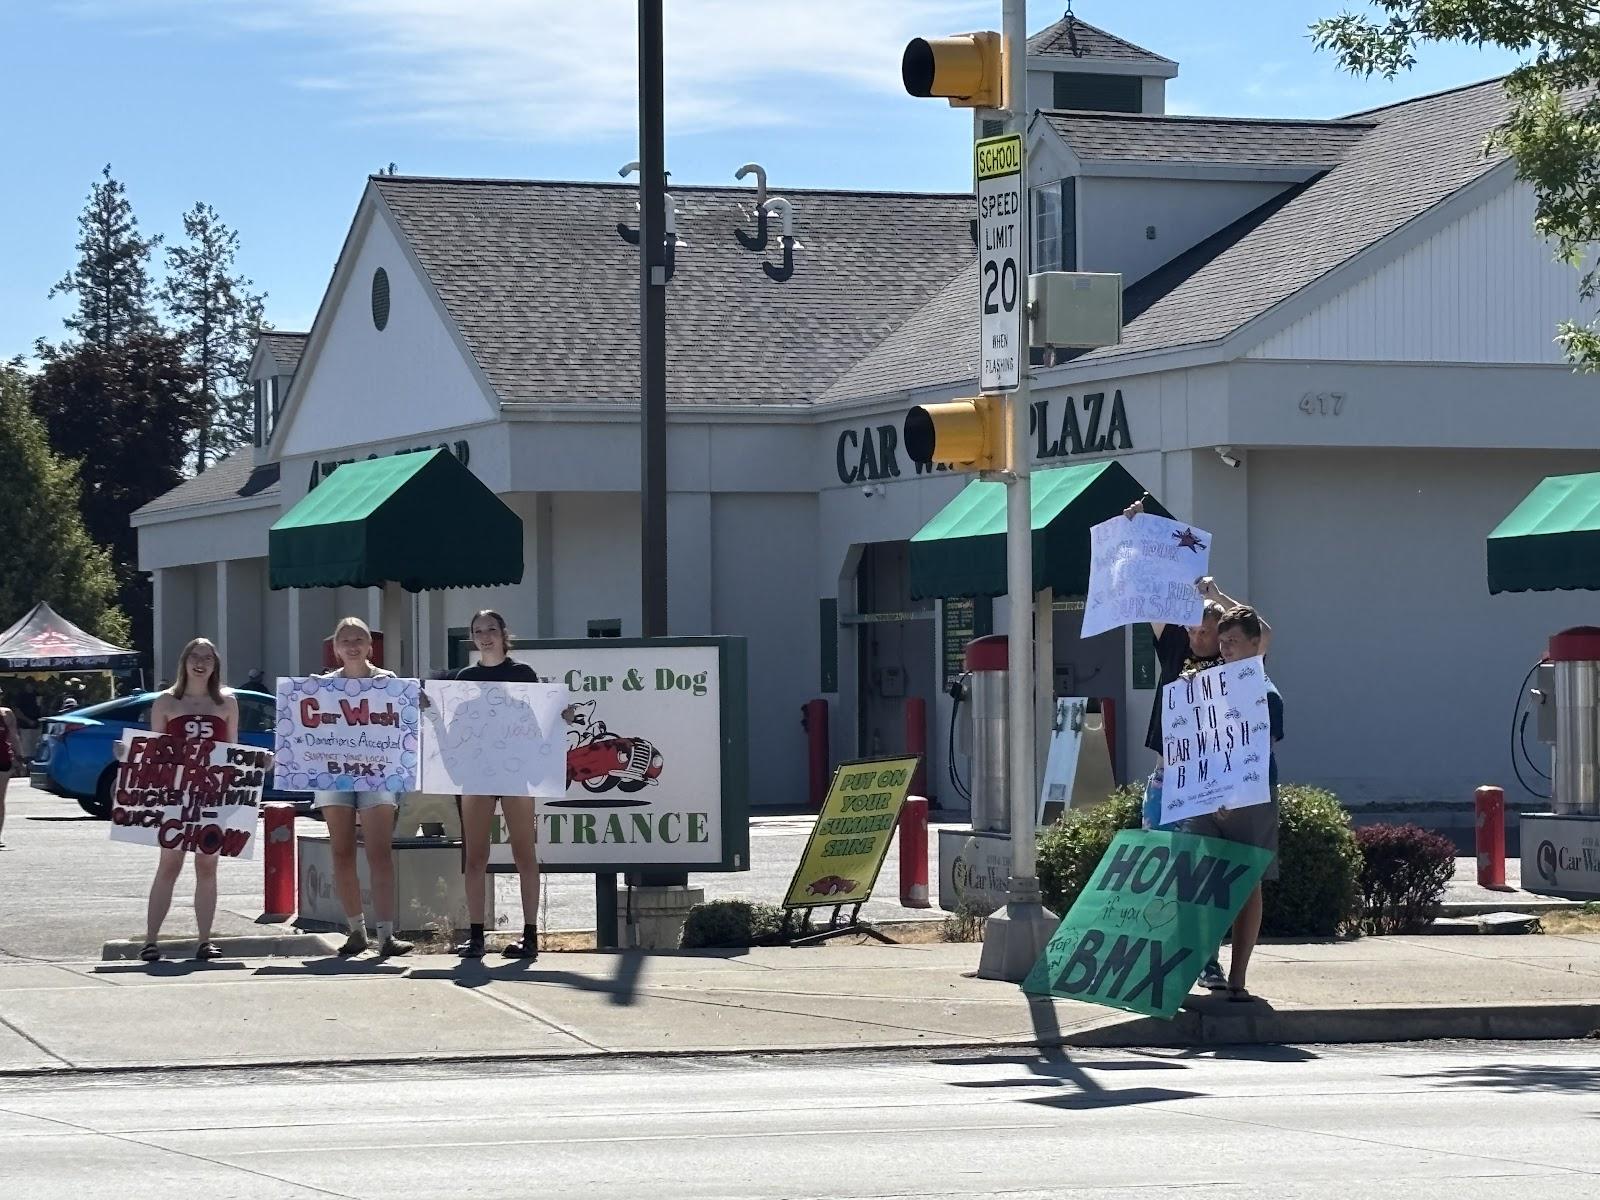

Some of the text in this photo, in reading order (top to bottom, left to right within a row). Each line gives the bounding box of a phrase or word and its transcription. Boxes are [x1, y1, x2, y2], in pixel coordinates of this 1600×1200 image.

[979, 147, 1019, 174] SCHOOL
[981, 191, 1019, 218] SPEED
[985, 224, 1015, 250] LIMIT
[984, 257, 1017, 314] 20
[992, 334, 1008, 348] WHEN
[985, 357, 1014, 374] FLASHING
[1298, 391, 1344, 416] 417
[836, 424, 900, 484] CAR
[564, 668, 708, 697] Car & Dog
[1168, 671, 1229, 711] COME
[300, 697, 400, 729] Car Wash
[1193, 705, 1217, 731] TO
[184, 721, 215, 739] 95
[304, 732, 357, 748] Donations
[1166, 720, 1251, 767] CAR WASH
[127, 734, 217, 768] FASTER
[839, 768, 908, 791] PUT ON
[1177, 750, 1233, 790] BMX
[839, 792, 892, 813] YOUR
[158, 818, 252, 858] CHOW
[819, 814, 896, 835] SUMMER
[820, 836, 876, 858] SHINE
[1558, 846, 1582, 871] Car
[1096, 843, 1251, 911] HONK
[1102, 895, 1142, 929] if you
[1052, 928, 1194, 1010] BMX
